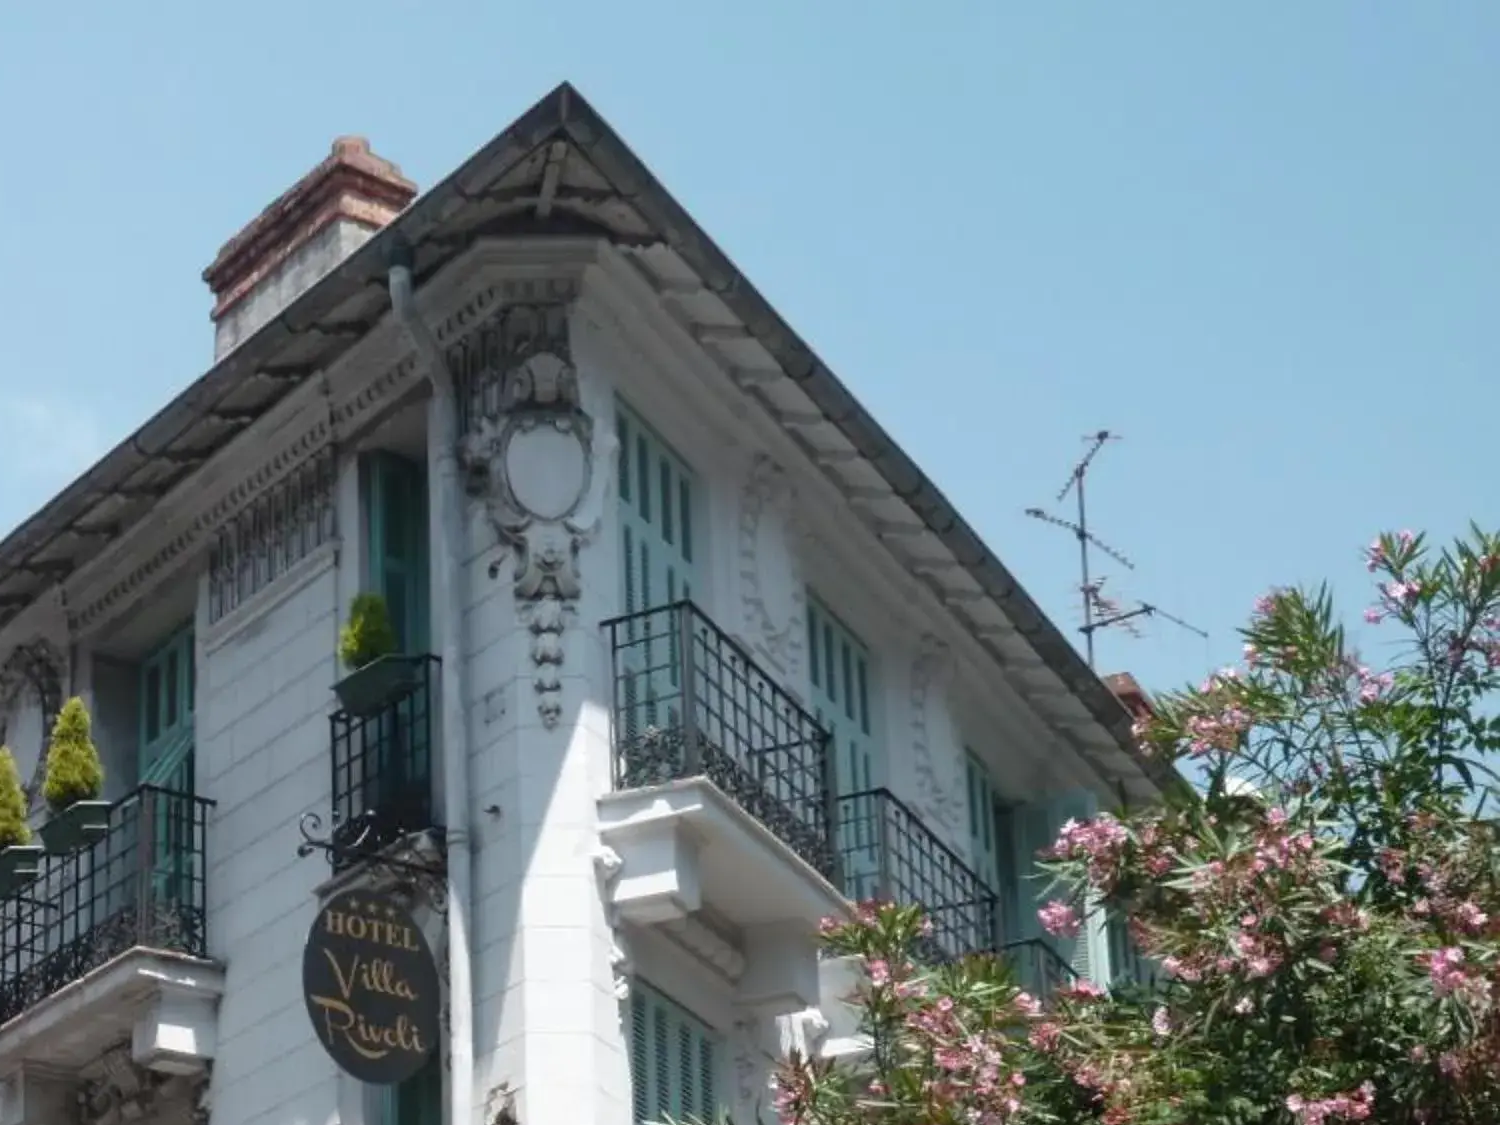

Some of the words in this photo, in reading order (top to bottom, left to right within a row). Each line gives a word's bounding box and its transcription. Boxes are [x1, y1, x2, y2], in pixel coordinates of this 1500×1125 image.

[326, 911, 419, 949] HOTEL
[325, 950, 418, 1000] Villa
[311, 995, 425, 1059] Rivoli
